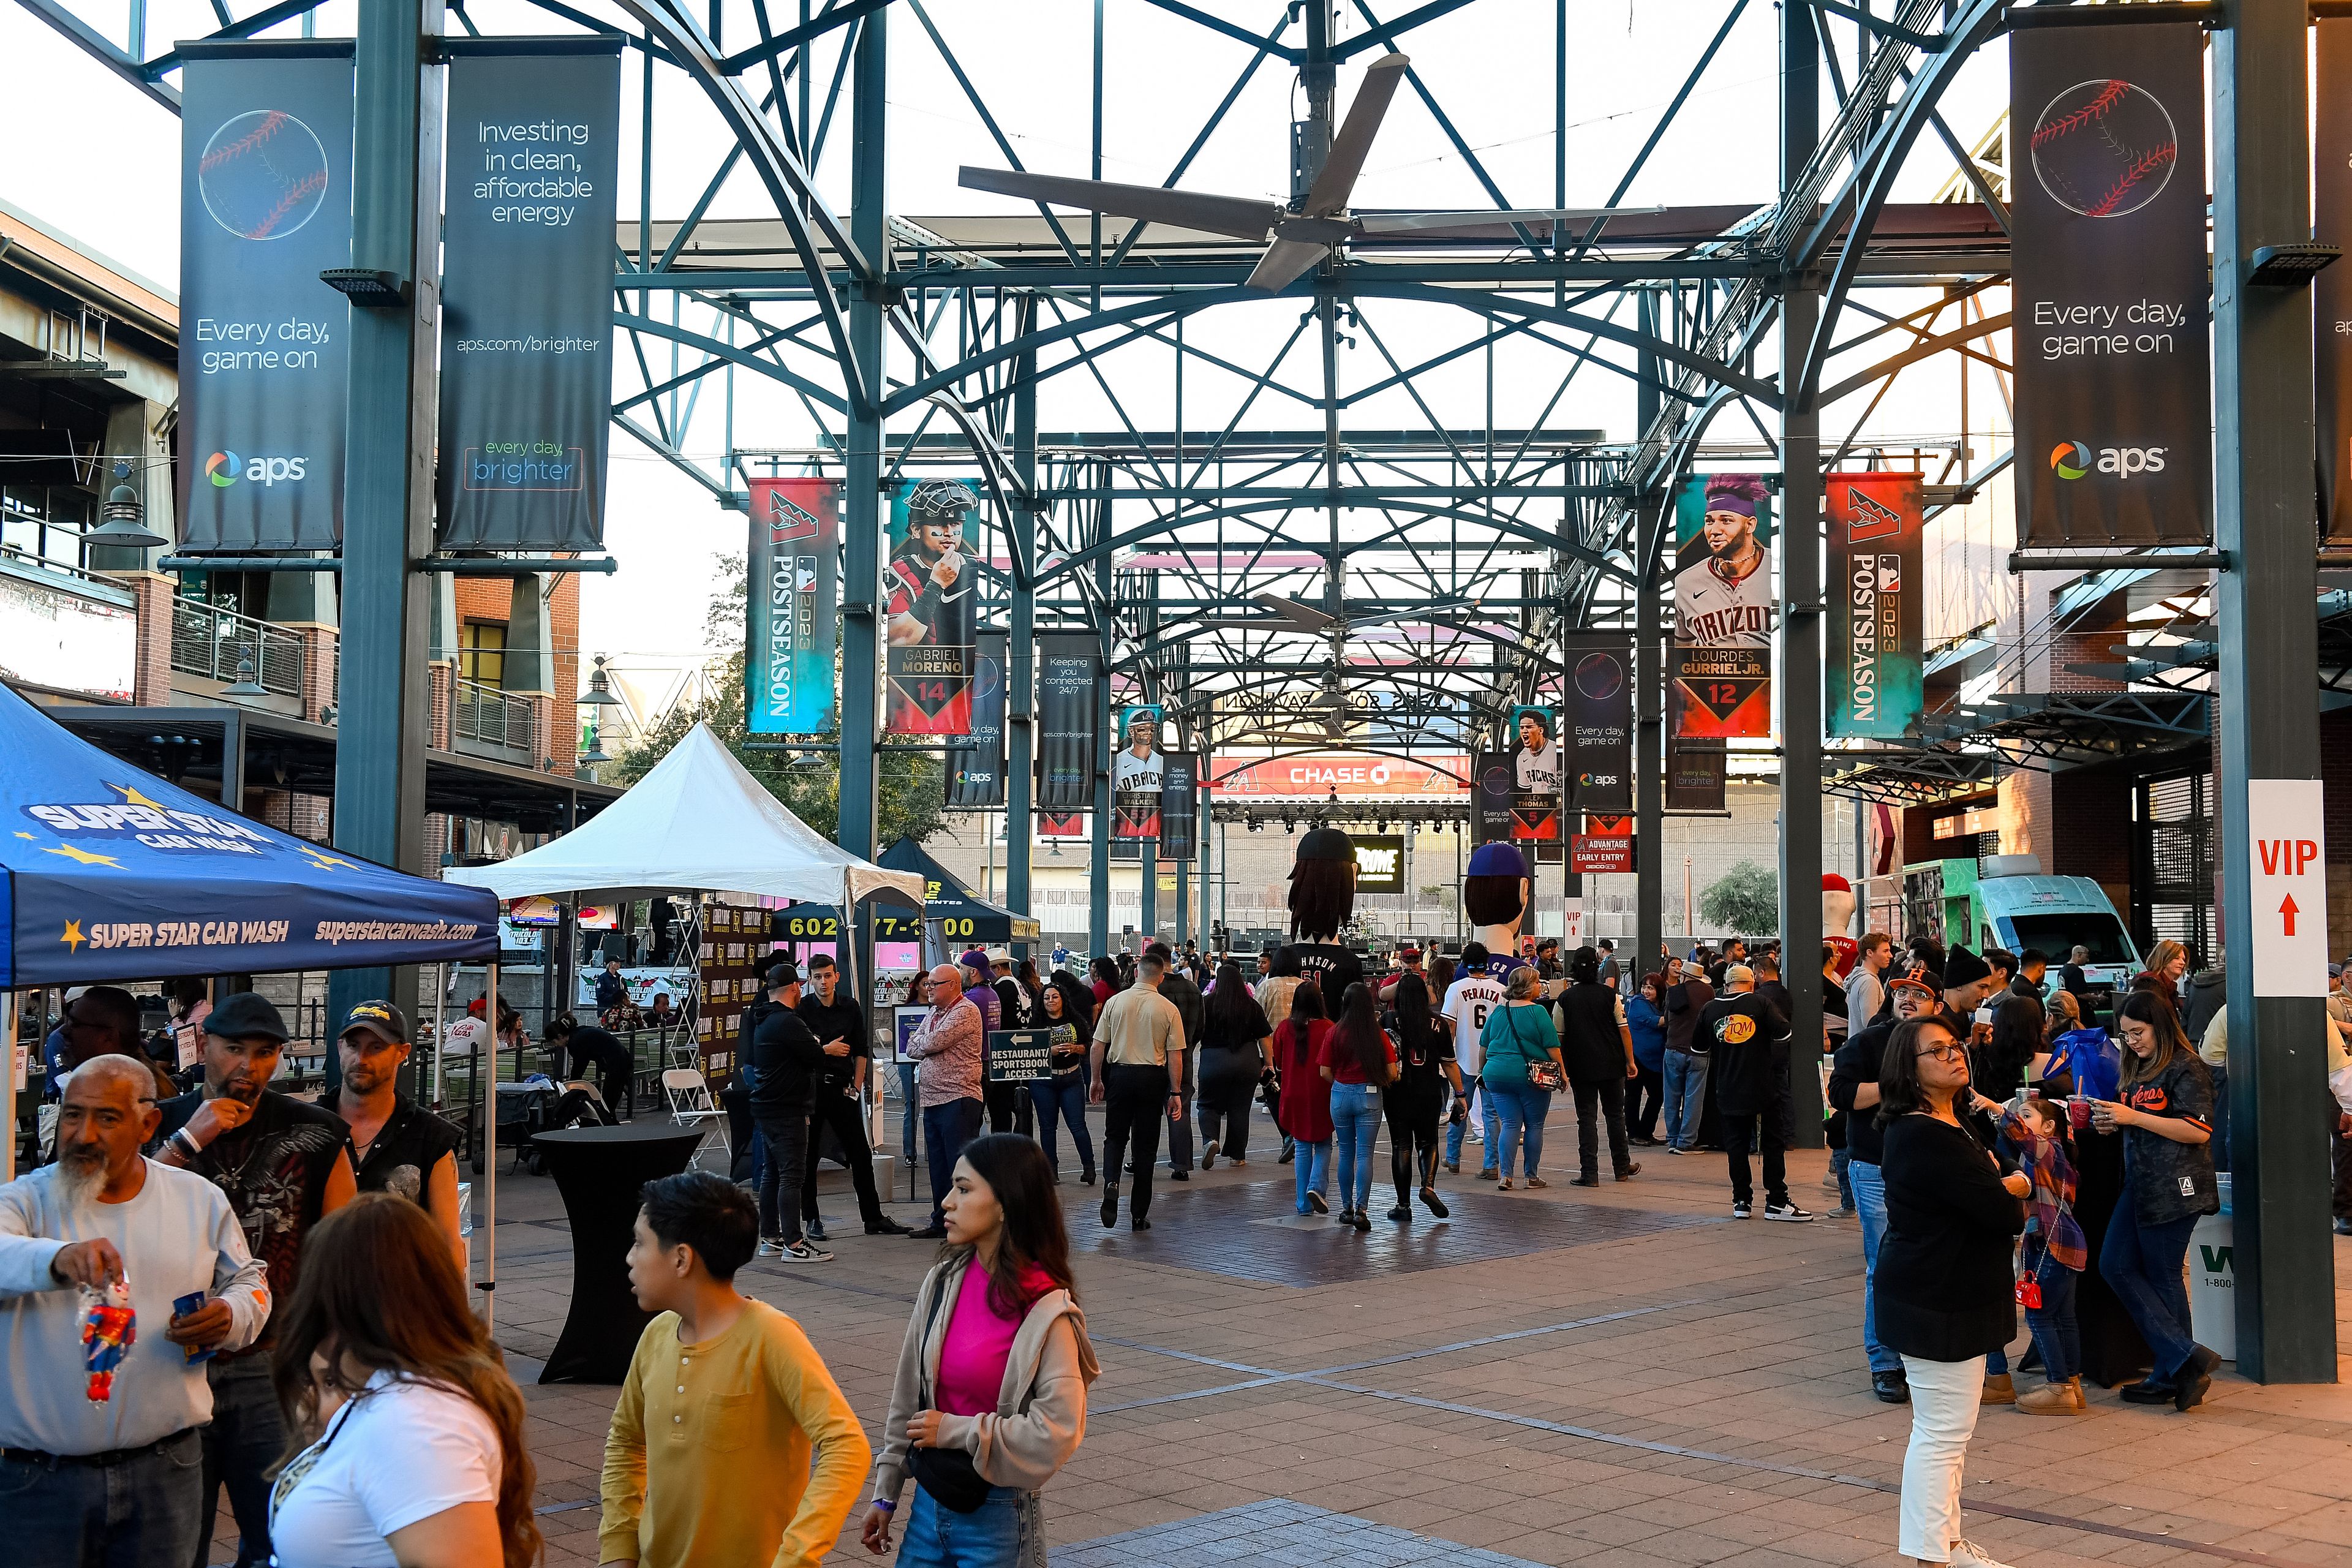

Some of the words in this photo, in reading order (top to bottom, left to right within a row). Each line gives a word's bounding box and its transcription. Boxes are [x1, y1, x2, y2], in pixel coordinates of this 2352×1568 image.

[478, 121, 589, 146] Investing
[486, 149, 505, 172] in
[511, 149, 581, 175] clean,
[473, 177, 592, 199] affordable
[492, 204, 575, 227] energy
[2034, 301, 2119, 328] Every
[2126, 298, 2186, 326] day,
[197, 318, 271, 346] Every
[277, 317, 330, 347] day,
[457, 336, 600, 355] aps.com/brighter
[2042, 333, 2129, 361] game
[2135, 331, 2173, 354] on
[202, 350, 279, 375] game
[284, 349, 318, 369] on
[486, 440, 528, 456] every
[533, 439, 564, 456] day,
[246, 455, 306, 488] aps
[473, 458, 571, 484] brighter
[2098, 446, 2166, 479] aps
[798, 594, 812, 650] 2023
[1883, 594, 1896, 653] 2023
[769, 556, 793, 717] POSTSEASON
[1853, 554, 1875, 722] POSTSEASON
[905, 649, 960, 661] GABRIEL
[1050, 658, 1087, 668] Keeping
[1692, 650, 1754, 662] LOURDES
[902, 662, 962, 673] MORENO
[1681, 663, 1741, 674] GURRIEL
[1742, 663, 1765, 674] JR.
[918, 681, 946, 701] 14
[1058, 686, 1079, 695] 24/7
[1708, 684, 1736, 704] 12
[980, 725, 1000, 735] day,
[1575, 726, 1603, 736] Every
[1605, 725, 1624, 736] day,
[954, 736, 982, 745] game
[1578, 736, 1605, 747] game
[1607, 736, 1621, 745] on
[970, 773, 992, 783] aps
[1049, 774, 1085, 783] brighter
[1289, 767, 1366, 784] CHASE
[1594, 774, 1618, 788] aps
[1678, 777, 1714, 786] brighter
[1130, 809, 1148, 820] 53
[1528, 812, 1538, 822] 5
[29, 805, 183, 831] SUPER
[167, 810, 276, 843] STAR
[135, 834, 199, 850] CAR
[187, 835, 264, 854] WASH
[2257, 839, 2318, 876] VIP
[1566, 911, 1581, 921] VIP
[89, 922, 154, 949] SUPER
[156, 921, 201, 947] STAR
[202, 920, 242, 946] CAR
[241, 919, 289, 944] WASH
[314, 918, 478, 941] superstarcarwash.com
[1908, 968, 1925, 982] H
[1461, 989, 1499, 1005] PERALTA
[1473, 1003, 1487, 1030] 6
[991, 1048, 1050, 1060] RESTAURANT/
[992, 1060, 1049, 1069] SPORTSBOOK
[1005, 1069, 1038, 1079] ACCESS
